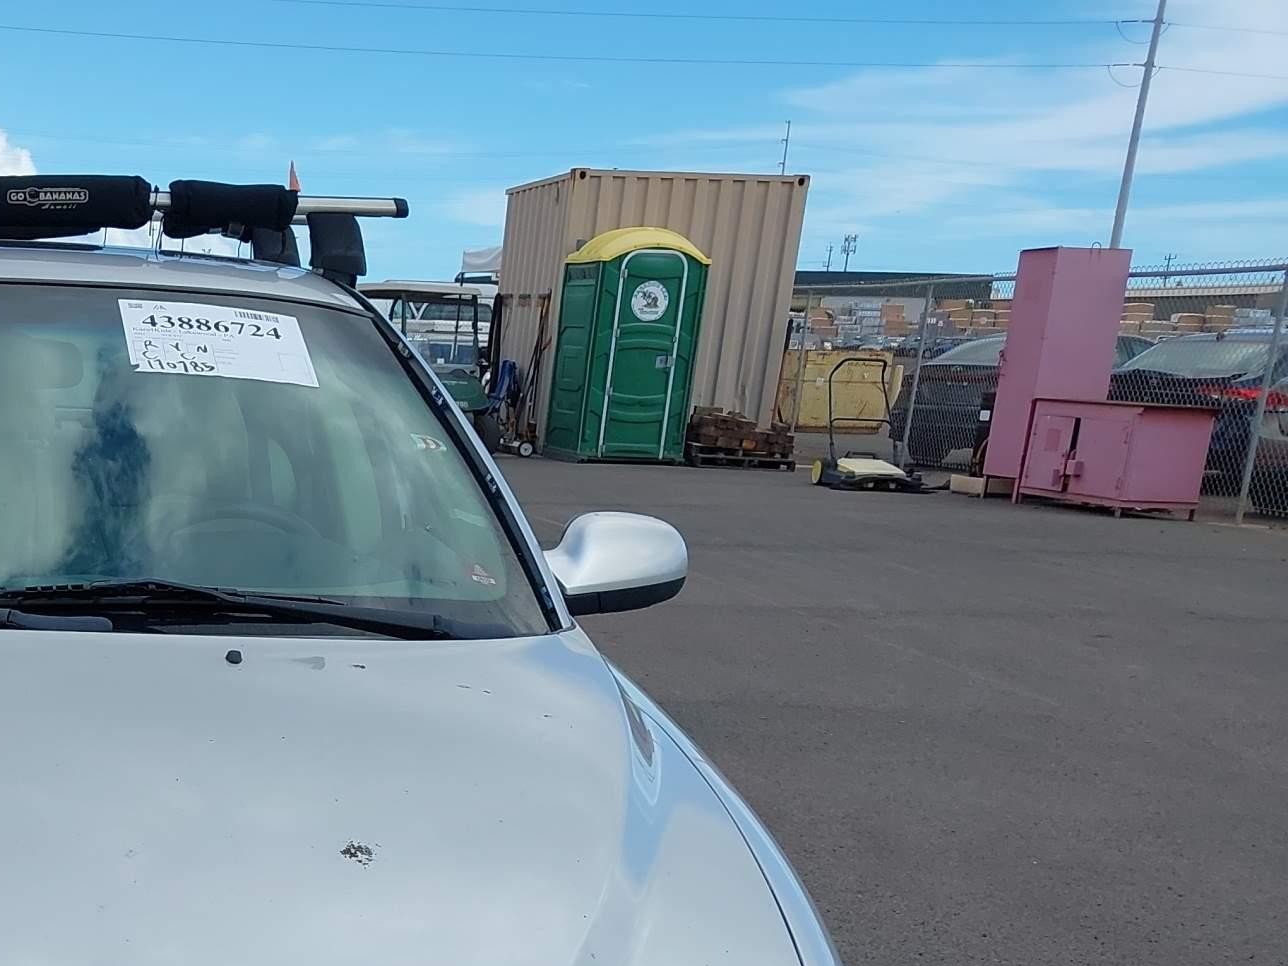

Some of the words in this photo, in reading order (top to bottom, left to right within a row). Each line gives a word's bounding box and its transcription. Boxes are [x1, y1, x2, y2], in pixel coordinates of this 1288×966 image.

[10, 192, 25, 201] GO
[39, 191, 86, 201] BANANAS
[141, 313, 283, 340] 43886724
